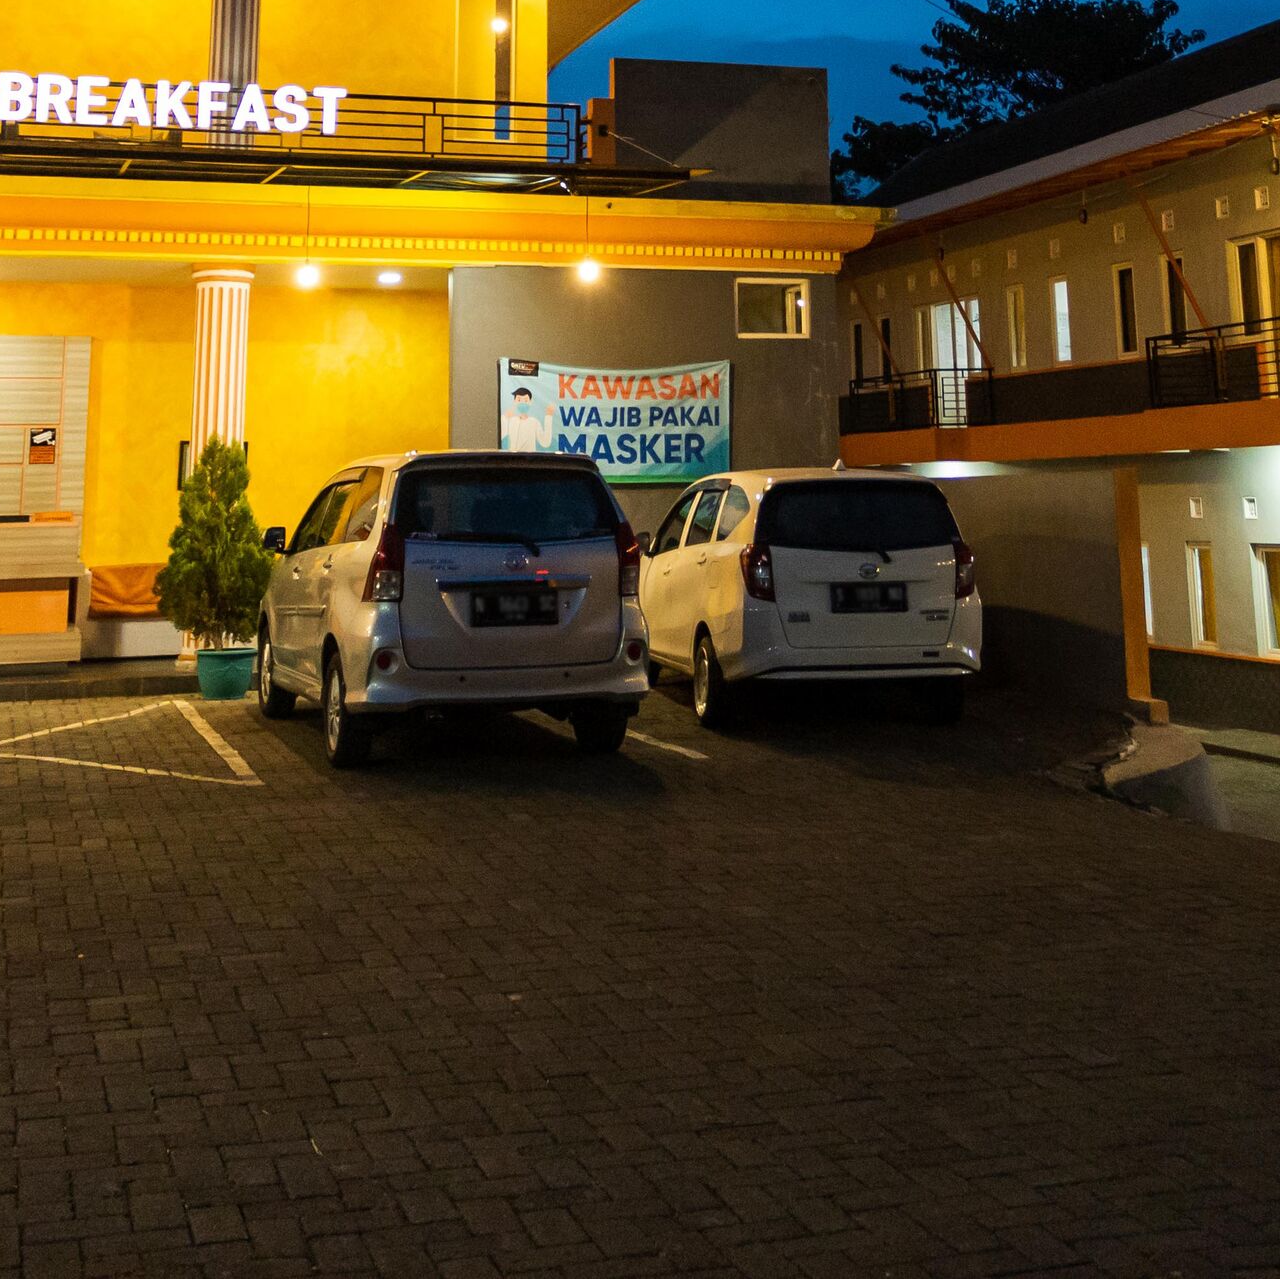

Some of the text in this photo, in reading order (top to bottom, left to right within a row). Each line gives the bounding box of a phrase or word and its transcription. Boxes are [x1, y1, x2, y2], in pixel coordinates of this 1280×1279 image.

[558, 373, 720, 401] KAWASAN
[559, 406, 720, 427] WAJIB PAKAI
[558, 433, 705, 465] MASKER
